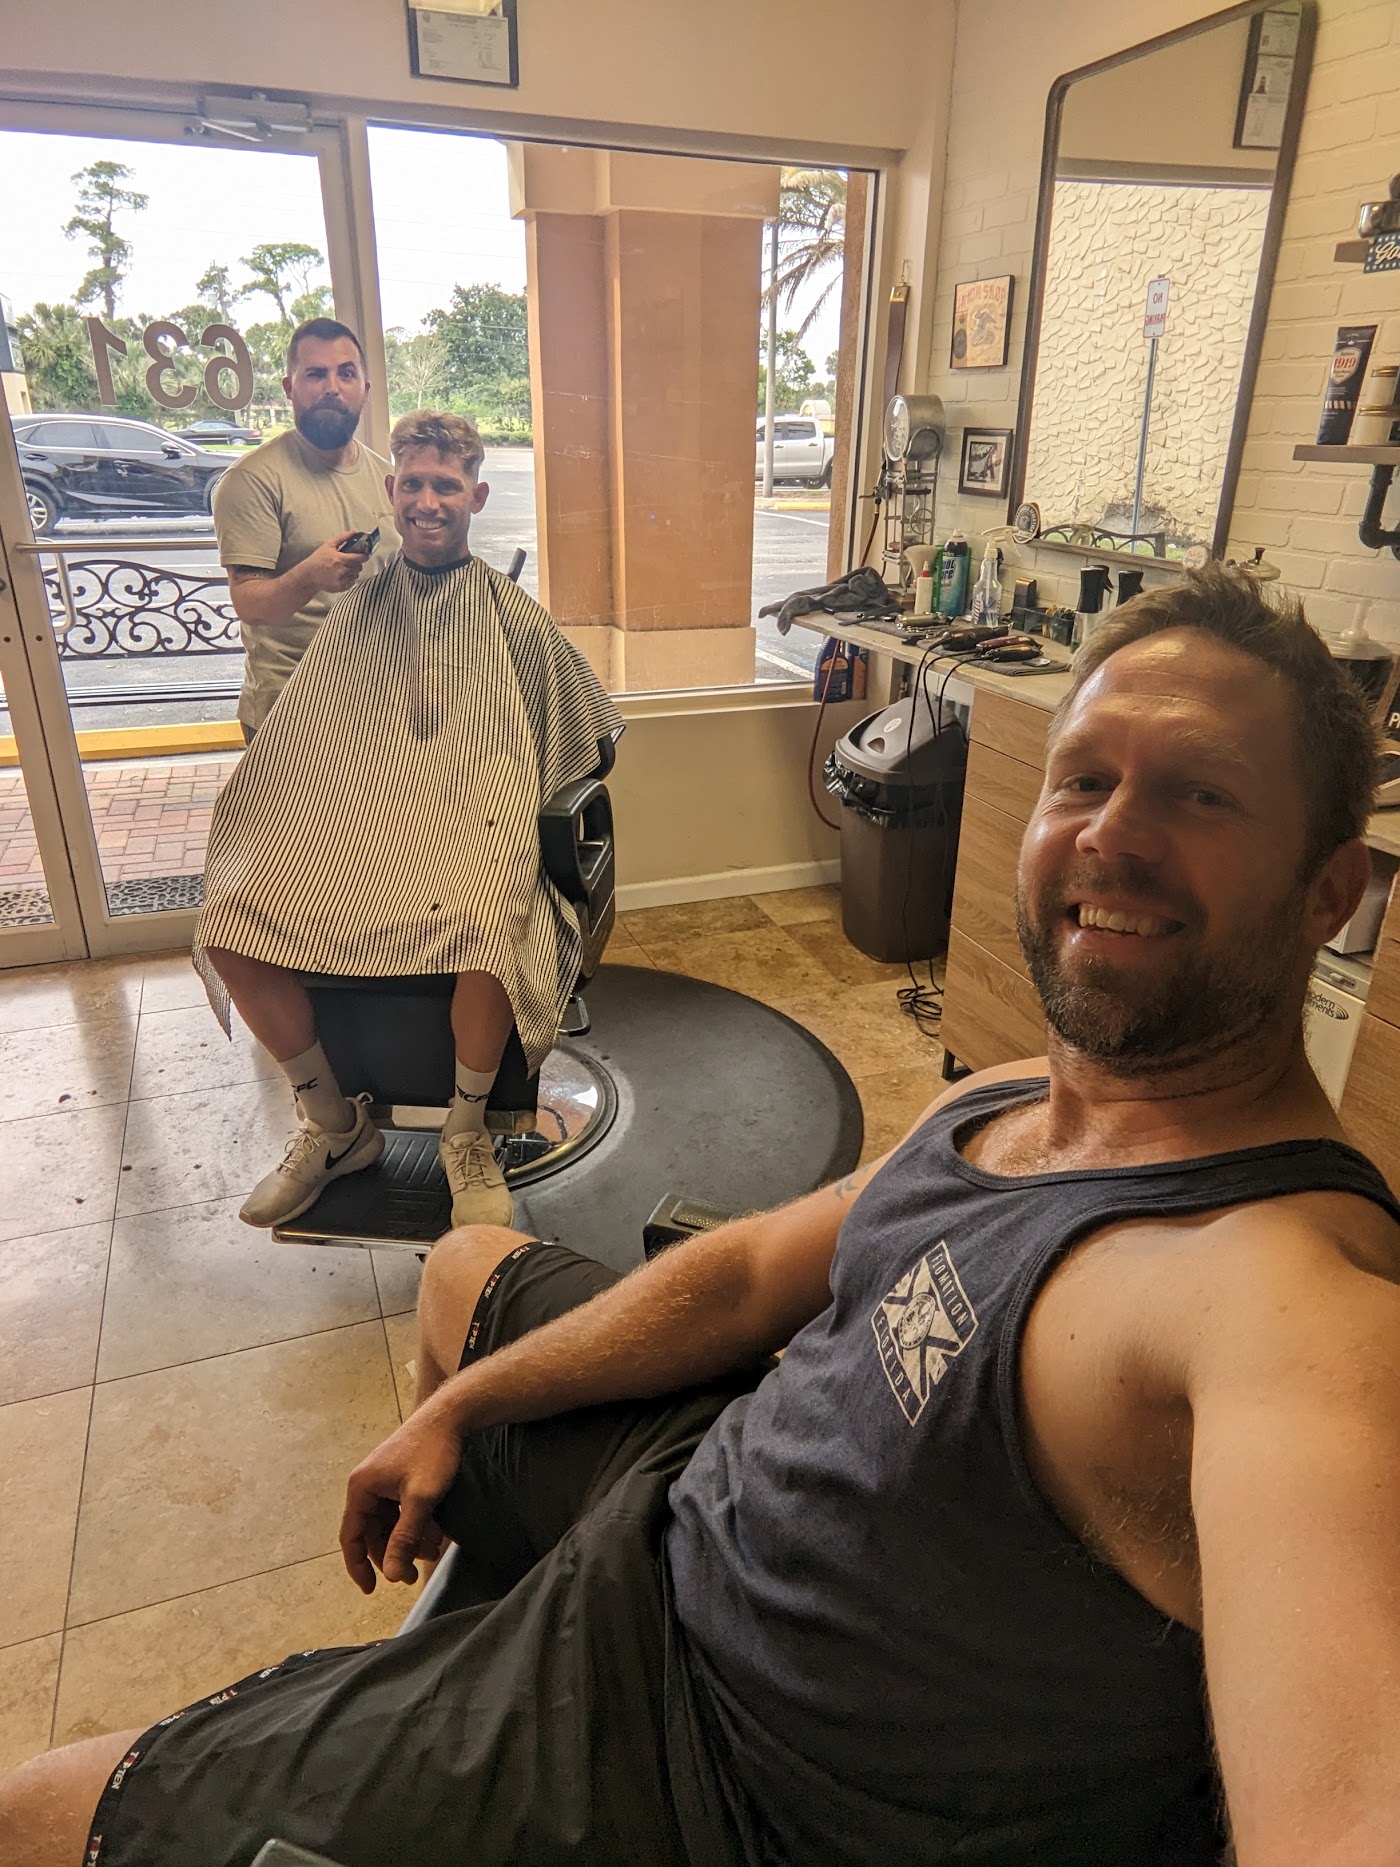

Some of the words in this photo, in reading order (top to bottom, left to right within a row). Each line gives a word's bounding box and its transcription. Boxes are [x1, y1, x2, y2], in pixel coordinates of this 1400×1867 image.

[1334, 358, 1357, 369] 1919
[931, 1253, 969, 1327] FLOMOTION
[876, 1316, 911, 1403] FLORIDA
[111, 1751, 140, 1790] TOPTEN
[86, 1834, 103, 1867] TOPT
